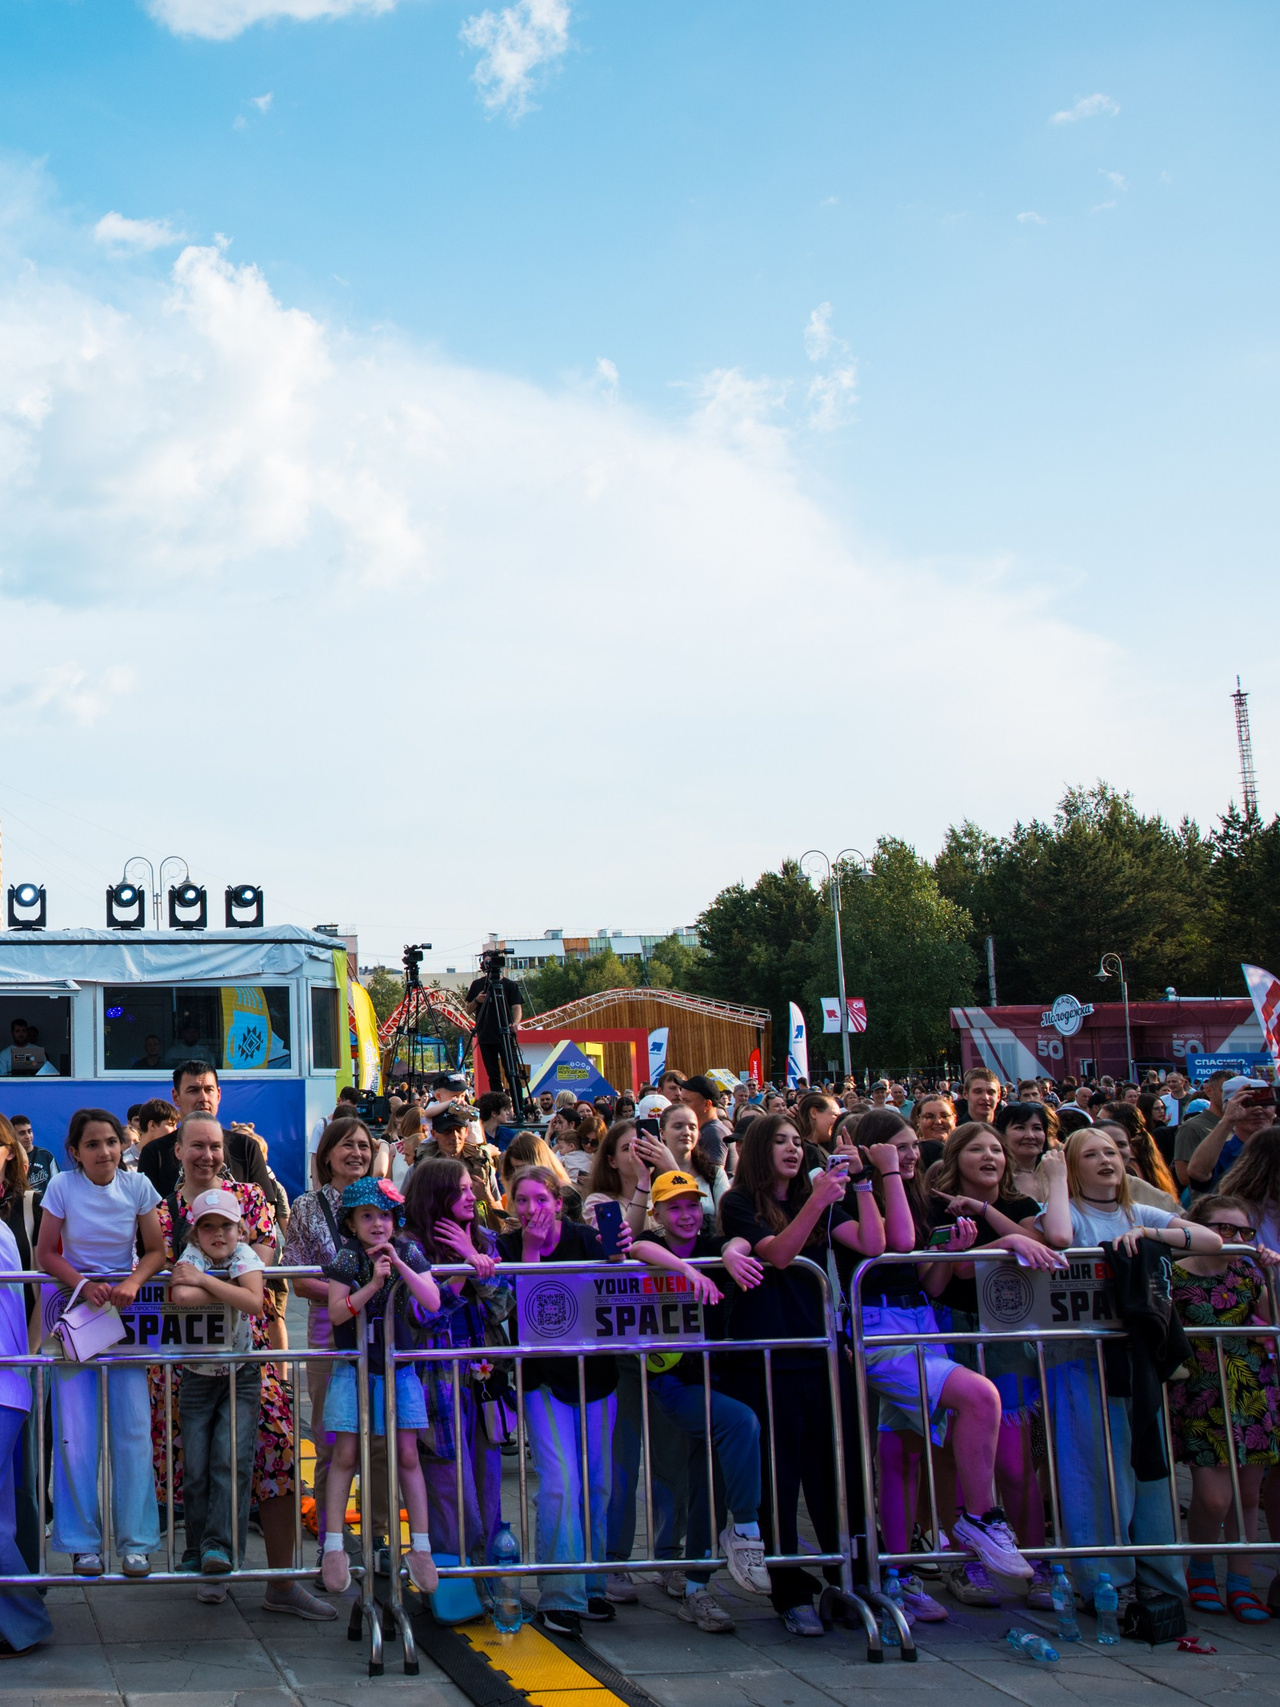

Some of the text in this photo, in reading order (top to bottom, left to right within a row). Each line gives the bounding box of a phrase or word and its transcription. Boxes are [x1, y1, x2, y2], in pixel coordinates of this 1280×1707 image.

[1056, 998, 1075, 1007] КАФЕ
[1041, 1005, 1091, 1025] Молодежка
[1037, 1040, 1063, 1059] 50
[1173, 1040, 1205, 1057] 50
[593, 1278, 640, 1295] YOUR
[118, 1314, 225, 1345] SPACE
[595, 1303, 701, 1337] SPACE
